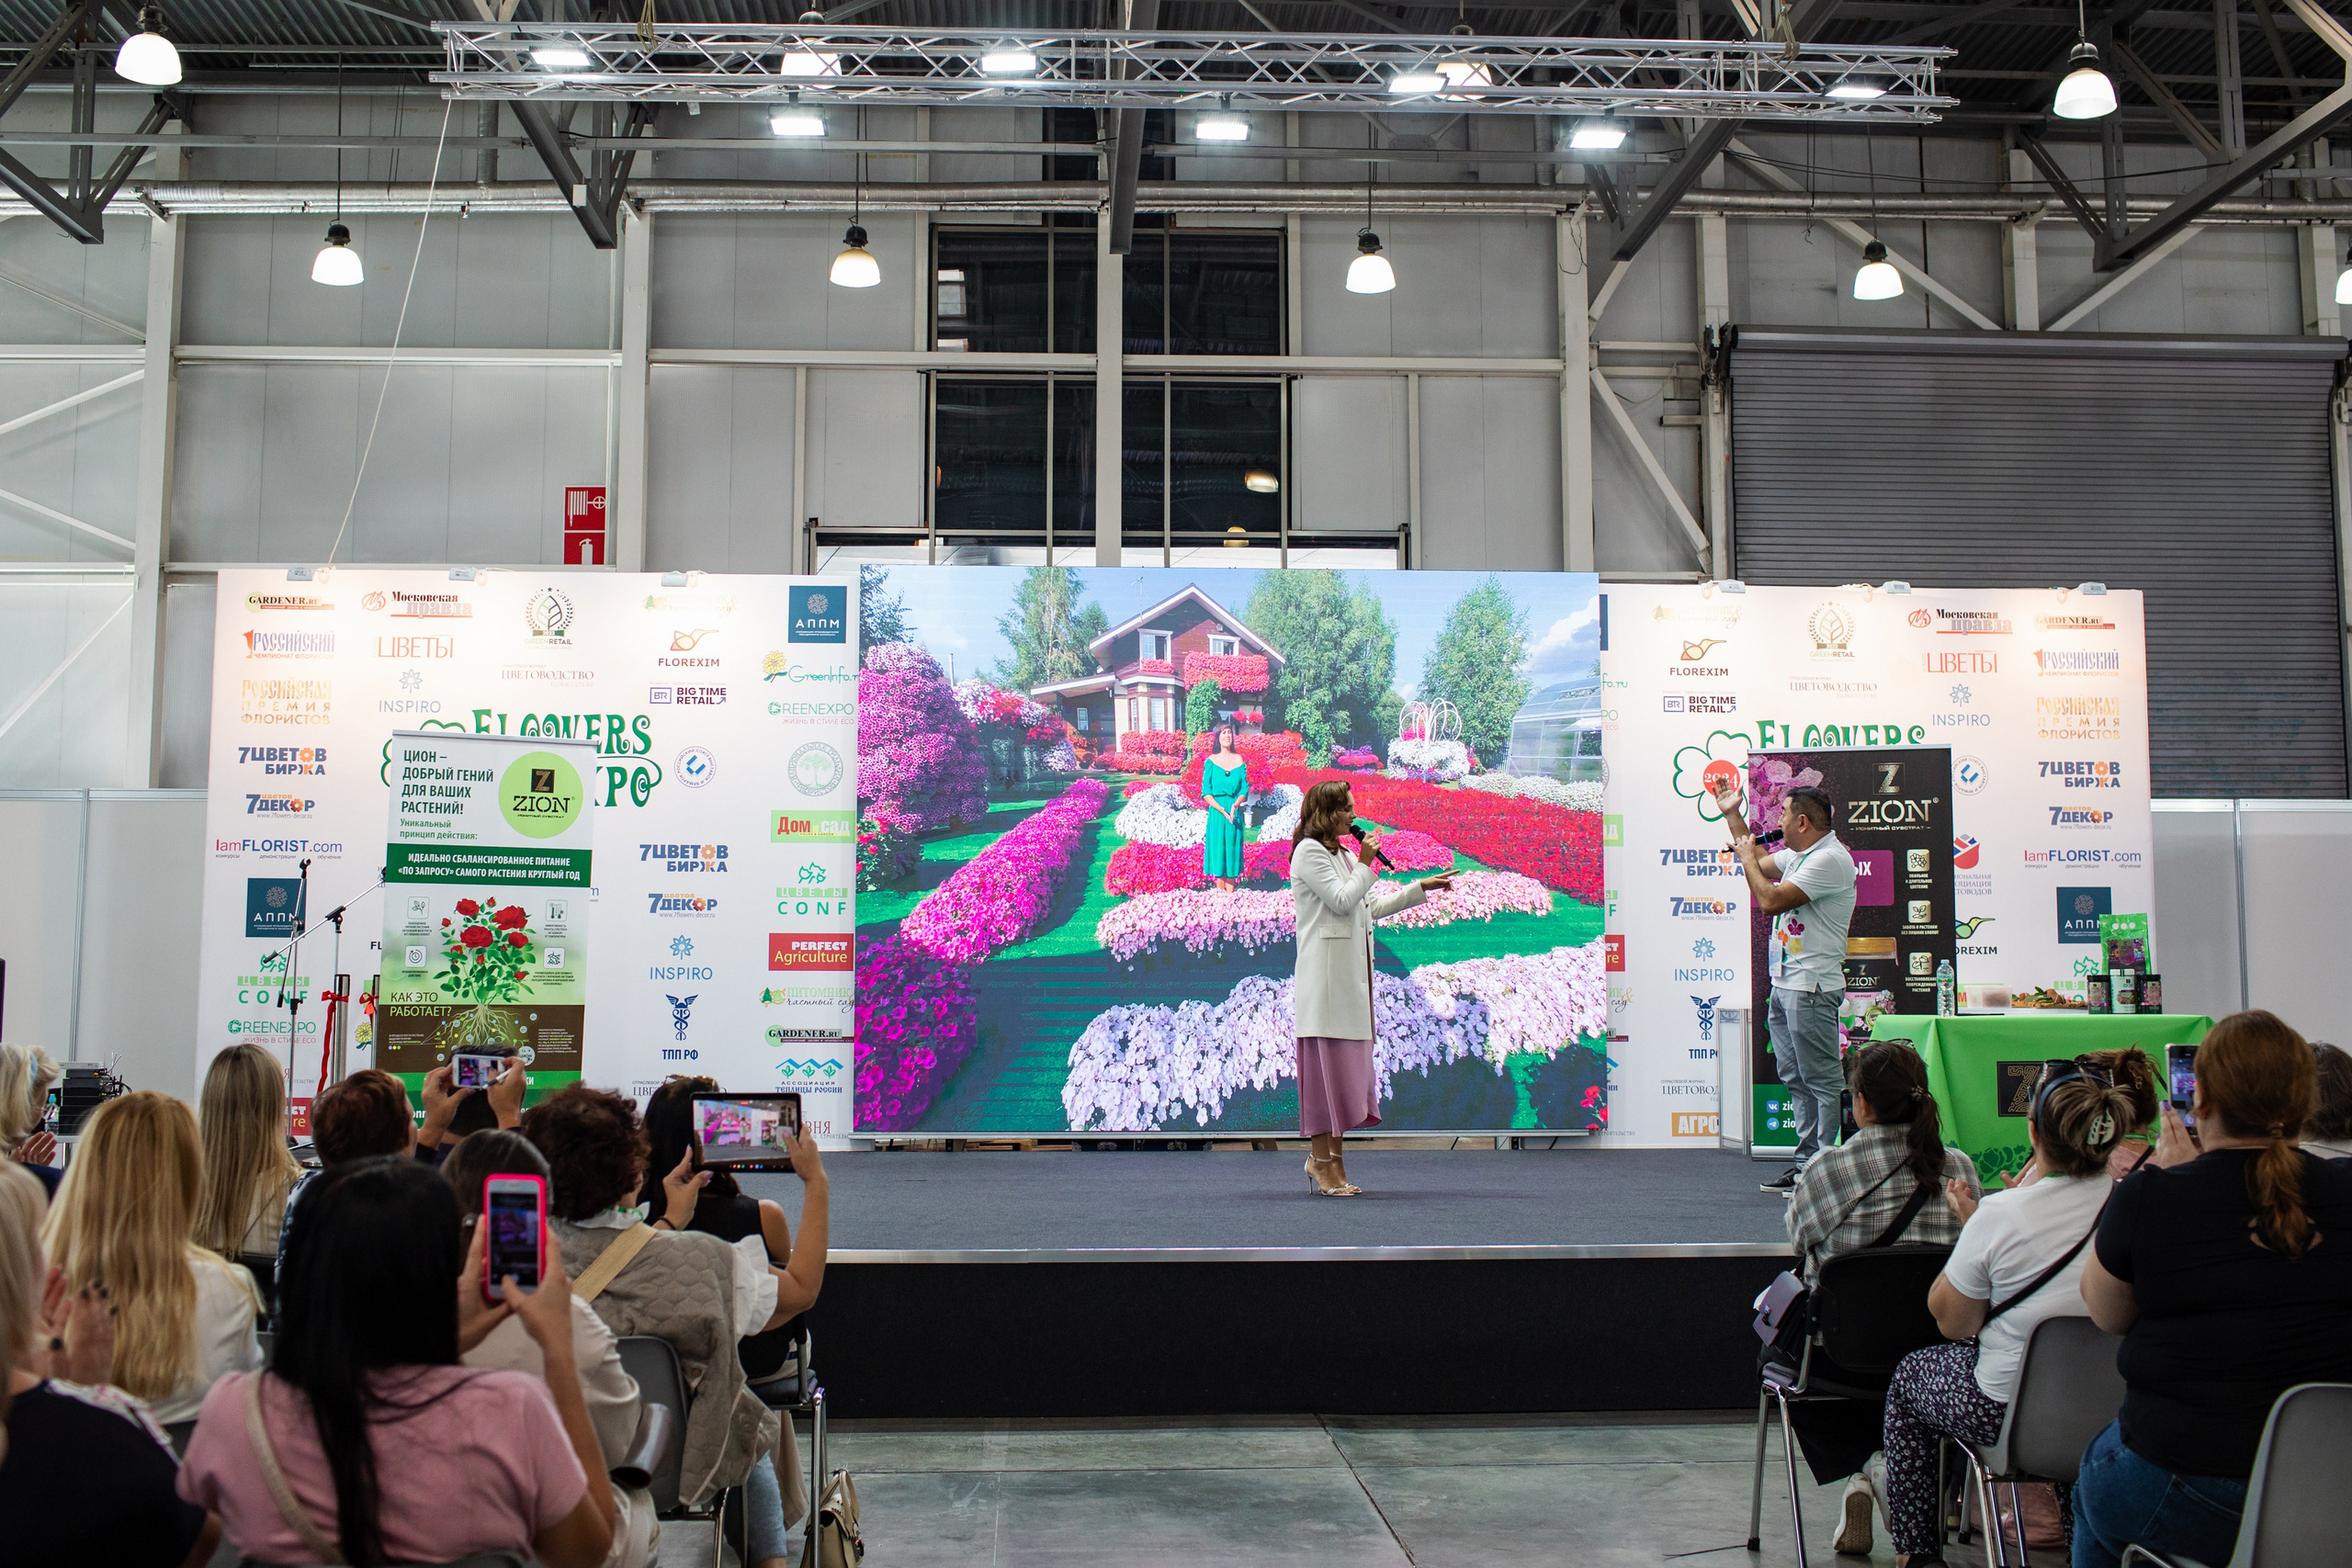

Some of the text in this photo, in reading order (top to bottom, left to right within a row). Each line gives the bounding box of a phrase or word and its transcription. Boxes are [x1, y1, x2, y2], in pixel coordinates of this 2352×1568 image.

[249, 595, 320, 605] GARDENER.RU
[390, 591, 458, 603] Московская
[406, 602, 472, 619] правда
[1936, 609, 1998, 619] Московская
[796, 618, 840, 628] АППМ
[1951, 619, 2013, 636] правда
[378, 637, 454, 658] ЦВЕТЫ
[658, 658, 720, 667] FLOREXIM
[1928, 652, 1997, 673] ЦВЕТЫ
[502, 670, 594, 680] ЦВЕТОВОДСТВО
[1669, 667, 1728, 676] FLOREXIM
[677, 687, 727, 695] BIG TIME
[1790, 682, 1878, 692] ЦВЕТОВОДСТВО
[677, 696, 716, 705] RETAIL
[1689, 696, 1736, 705] BIG TIME
[242, 702, 331, 712] ПРЕМИЯ
[379, 700, 441, 713] INSPIRO
[768, 701, 854, 716] GREENEXPO
[241, 714, 330, 725] ФЛОРИСТОВ
[1932, 714, 1991, 727] INSPIRO
[2038, 717, 2120, 728] ПРЕМИЯ
[2038, 729, 2120, 739] ФЛОРИСТОВ
[403, 750, 436, 763] ЦИОН
[266, 764, 326, 775] БИРЖА
[402, 767, 494, 783] ДОБРЫЙ ГЕНИЙ
[2064, 778, 2121, 788] БИРЖА
[401, 784, 471, 798] ДЛЯ ВАШИХ
[401, 801, 464, 815] РАСТЕНИЙ!
[400, 818, 451, 829] Уникальный
[777, 817, 811, 836] Дом
[821, 819, 851, 836] сад
[400, 829, 478, 840] принцип действия:
[216, 839, 343, 852] IamFLORIST.com
[408, 853, 571, 867] ИДЕАЛЬНО СБАЛАНСИРОВАННОЕ ПИТАНИЕ
[2024, 850, 2142, 863] IamFLORIST.com
[667, 862, 729, 873] БИРЖА
[1687, 866, 1745, 876] БИРЖА
[399, 866, 581, 882] «ПО ЗАПРОСУ» САМОГО РАСТЕНИЯ КРУГЛЫЙ ГОД
[782, 887, 842, 898] ЦВЕТЫ
[777, 901, 846, 915] CONF
[792, 942, 848, 951] PERFECT
[775, 950, 848, 965] Agriculture
[650, 967, 713, 980] INSPIRO
[1675, 969, 1735, 981] INSPIRO
[238, 990, 308, 1004] CONF
[390, 992, 438, 1003] КАК ЭТО
[787, 987, 850, 998] ПИТОМНИК
[786, 998, 833, 1006] частный
[1611, 998, 1628, 1013] сад
[390, 1006, 452, 1018] РАБОТАЕТ?
[769, 1029, 841, 1038] GARDENER.RU
[662, 1049, 699, 1060] ТПП РФ
[1689, 1049, 1707, 1059] ТПП
[775, 1086, 812, 1094] ТЕПЛИЦЫ
